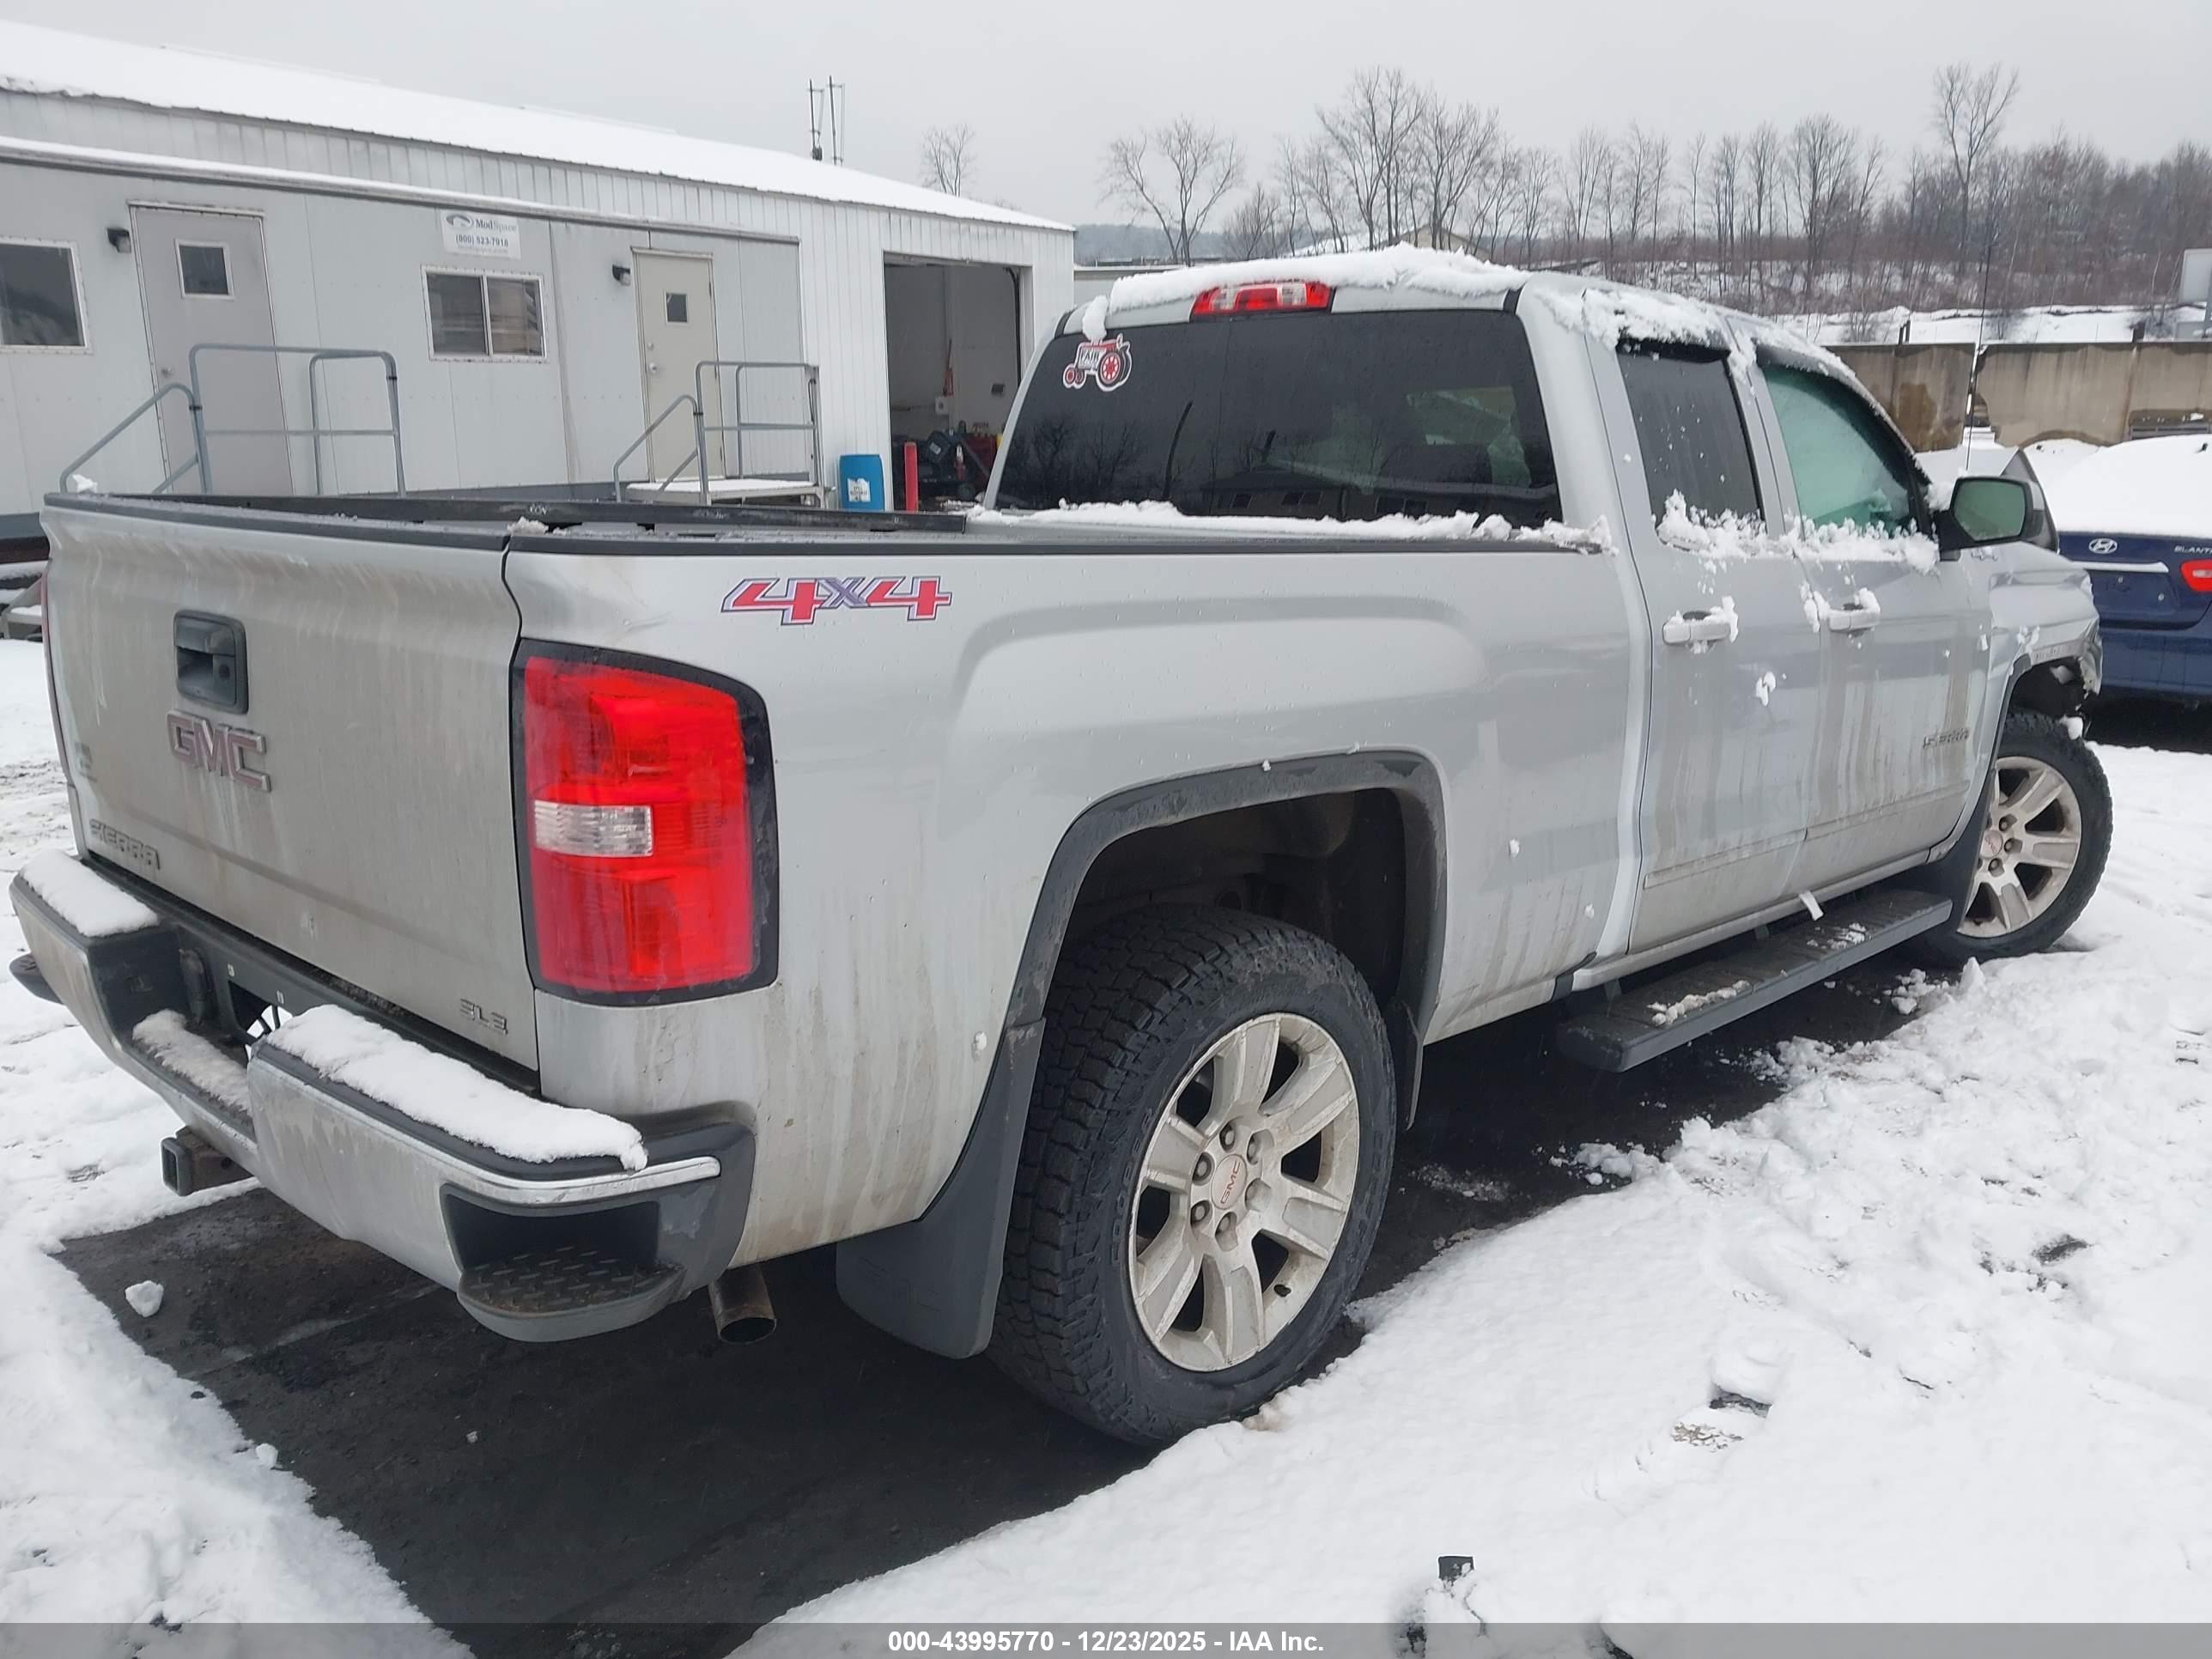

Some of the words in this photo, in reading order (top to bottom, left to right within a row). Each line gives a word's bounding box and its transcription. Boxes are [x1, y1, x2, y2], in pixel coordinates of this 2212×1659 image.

[455, 234, 474, 246] (800)
[2174, 545, 2212, 555] ELANT
[167, 711, 271, 793] GMC
[89, 818, 161, 870] SIERRA
[459, 998, 508, 1036] SLE
[1220, 1160, 1241, 1204] GMC
